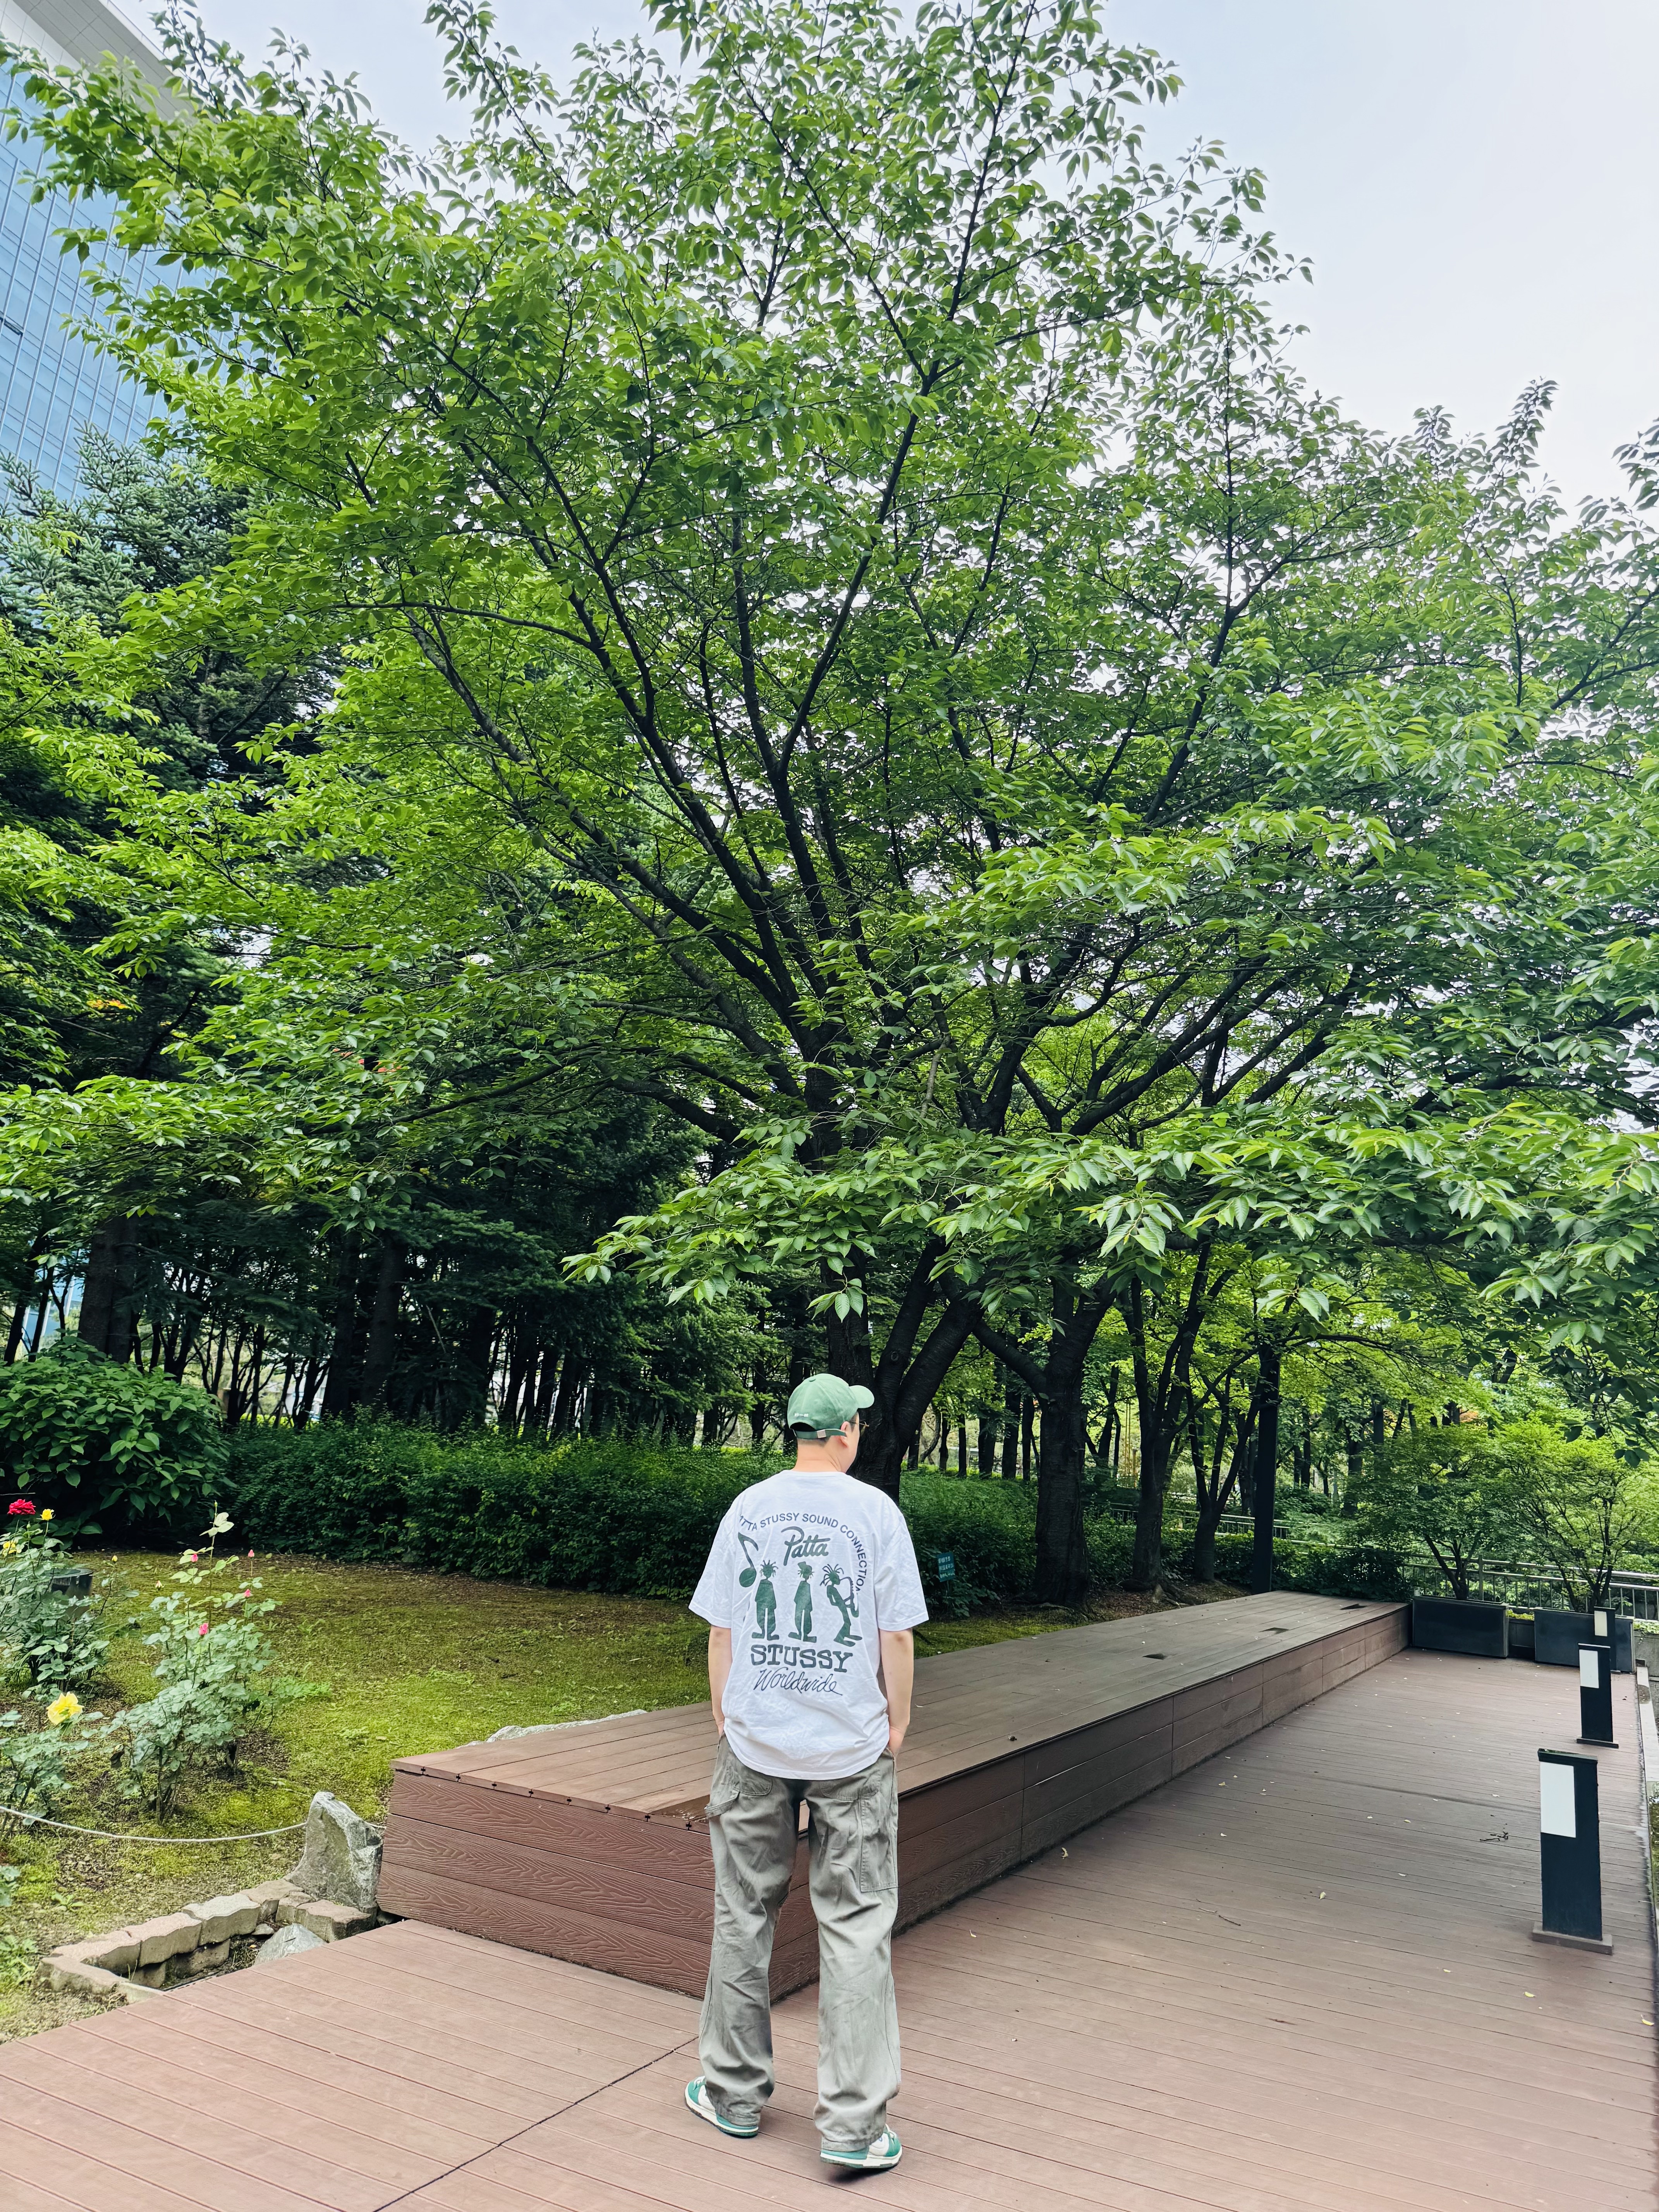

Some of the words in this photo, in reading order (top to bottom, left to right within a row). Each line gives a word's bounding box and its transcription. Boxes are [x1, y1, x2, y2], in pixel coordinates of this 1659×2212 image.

[760, 1513, 800, 1528] STUSSY
[802, 1513, 838, 1528] SOUND
[781, 1526, 831, 1566] Patta
[750, 1644, 853, 1673] STUSSY
[753, 1667, 843, 1695] Worldwide
